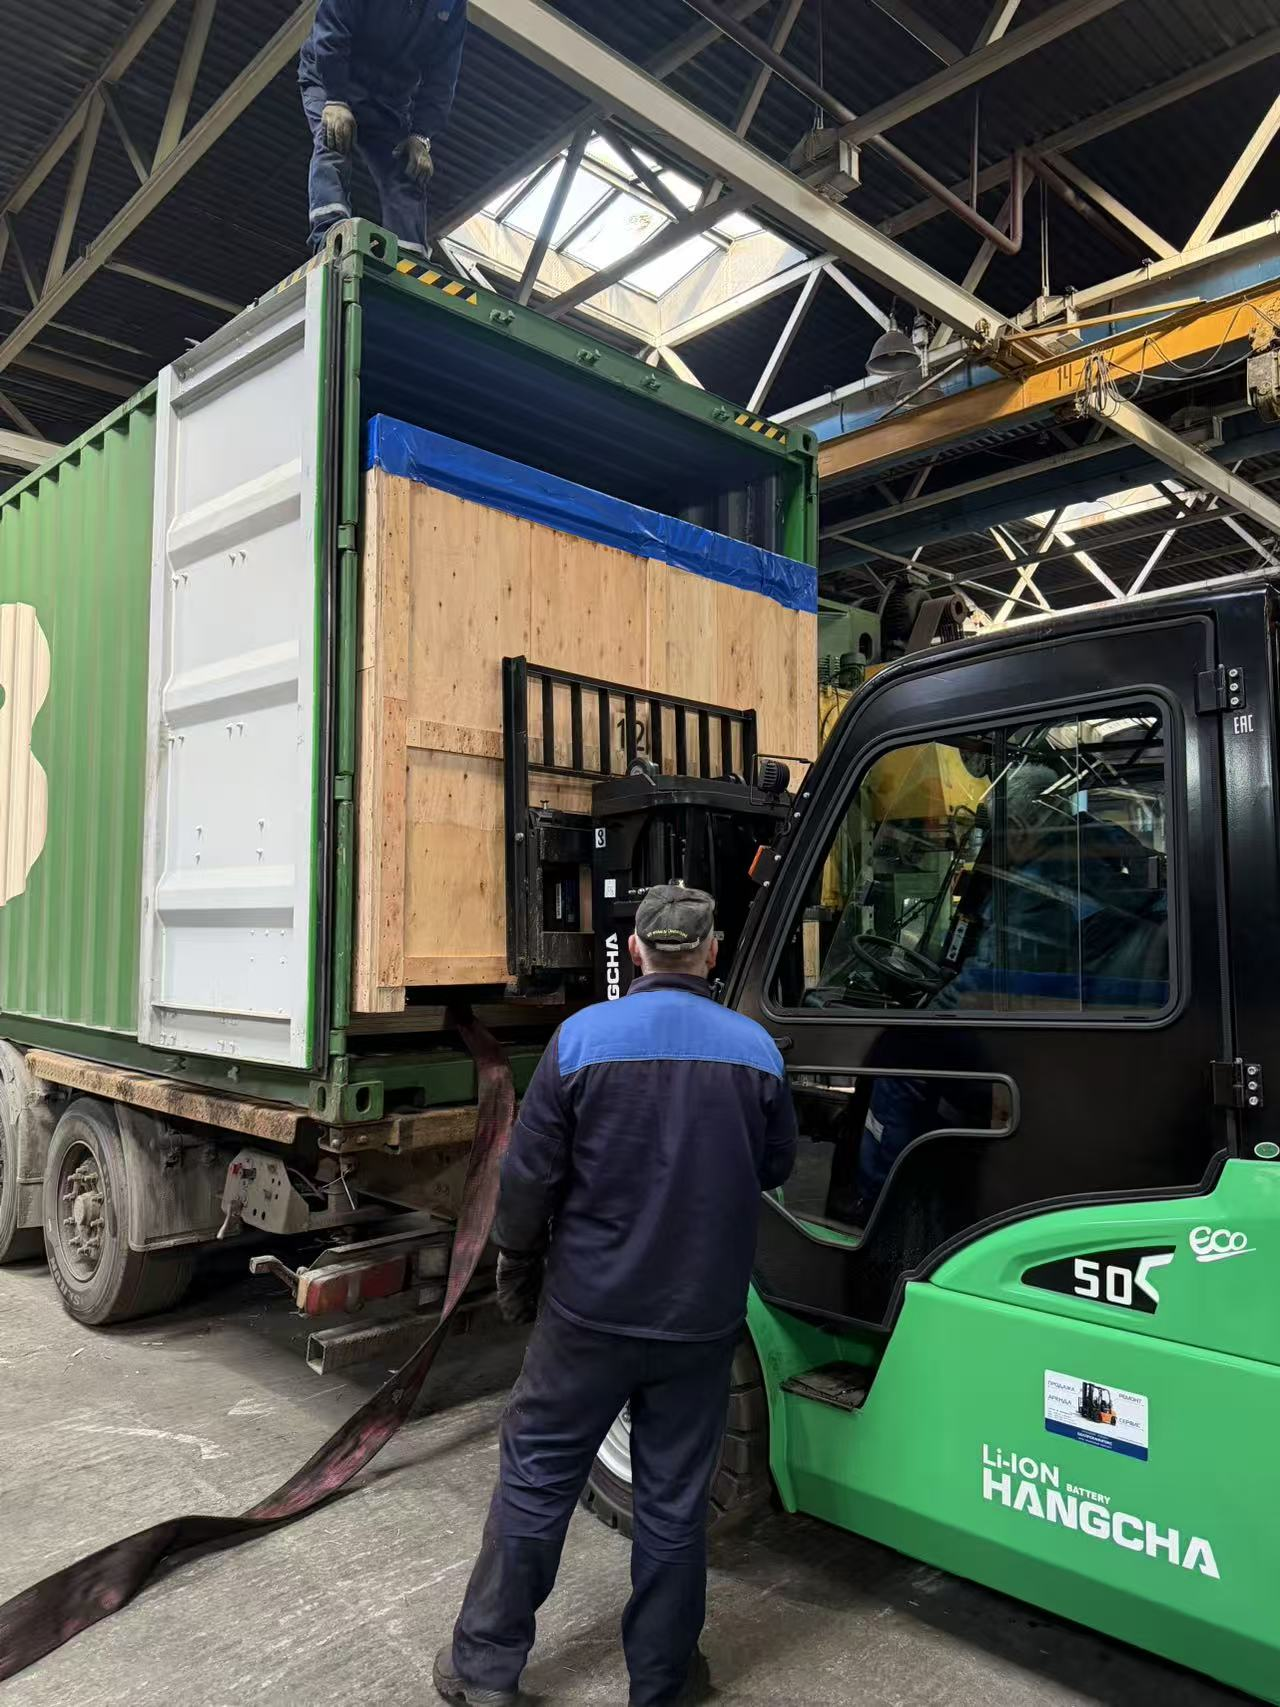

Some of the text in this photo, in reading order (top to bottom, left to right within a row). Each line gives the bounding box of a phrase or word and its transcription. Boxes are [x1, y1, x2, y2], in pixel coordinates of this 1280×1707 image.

[1233, 714, 1254, 735] EAC
[605, 932, 620, 1001] GCHA
[1066, 1483, 1111, 1505] BATTERY
[982, 1467, 1221, 1580] HANGCHA
